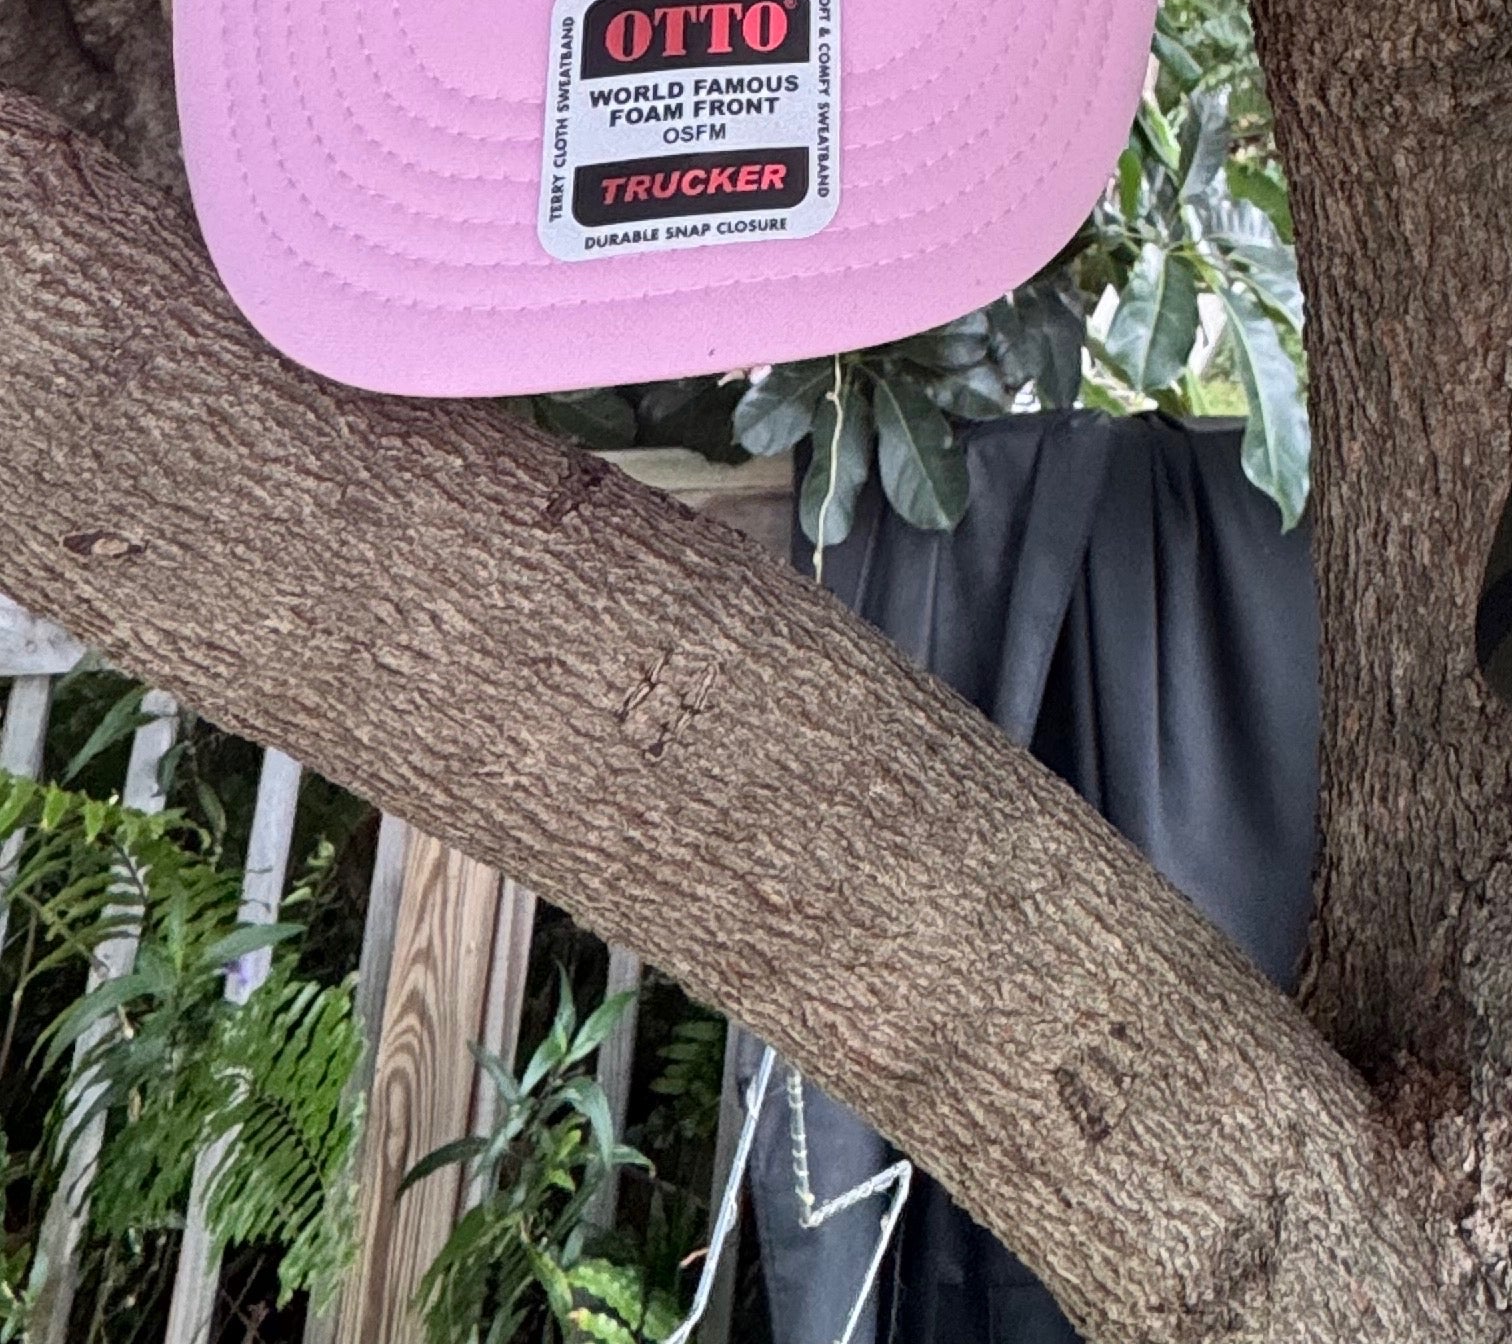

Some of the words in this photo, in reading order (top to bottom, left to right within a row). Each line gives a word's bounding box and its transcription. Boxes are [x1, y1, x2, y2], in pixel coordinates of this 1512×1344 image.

[818, 27, 830, 38] &
[557, 16, 575, 113] SWEATBAND
[818, 44, 830, 96] COMFY
[590, 82, 684, 107] WORLD
[694, 75, 799, 96] FAMOUS
[609, 103, 684, 127] FOAM
[693, 97, 779, 117] FRONT
[553, 117, 568, 168] CLOTH
[663, 124, 726, 143] OSFM
[817, 103, 830, 198] SWEATBAND
[549, 175, 566, 222] TERRY
[601, 164, 787, 205] TRUCKER
[584, 228, 659, 250] DURABLE
[665, 224, 711, 239] SNAP
[717, 218, 787, 234] CLOSURE
